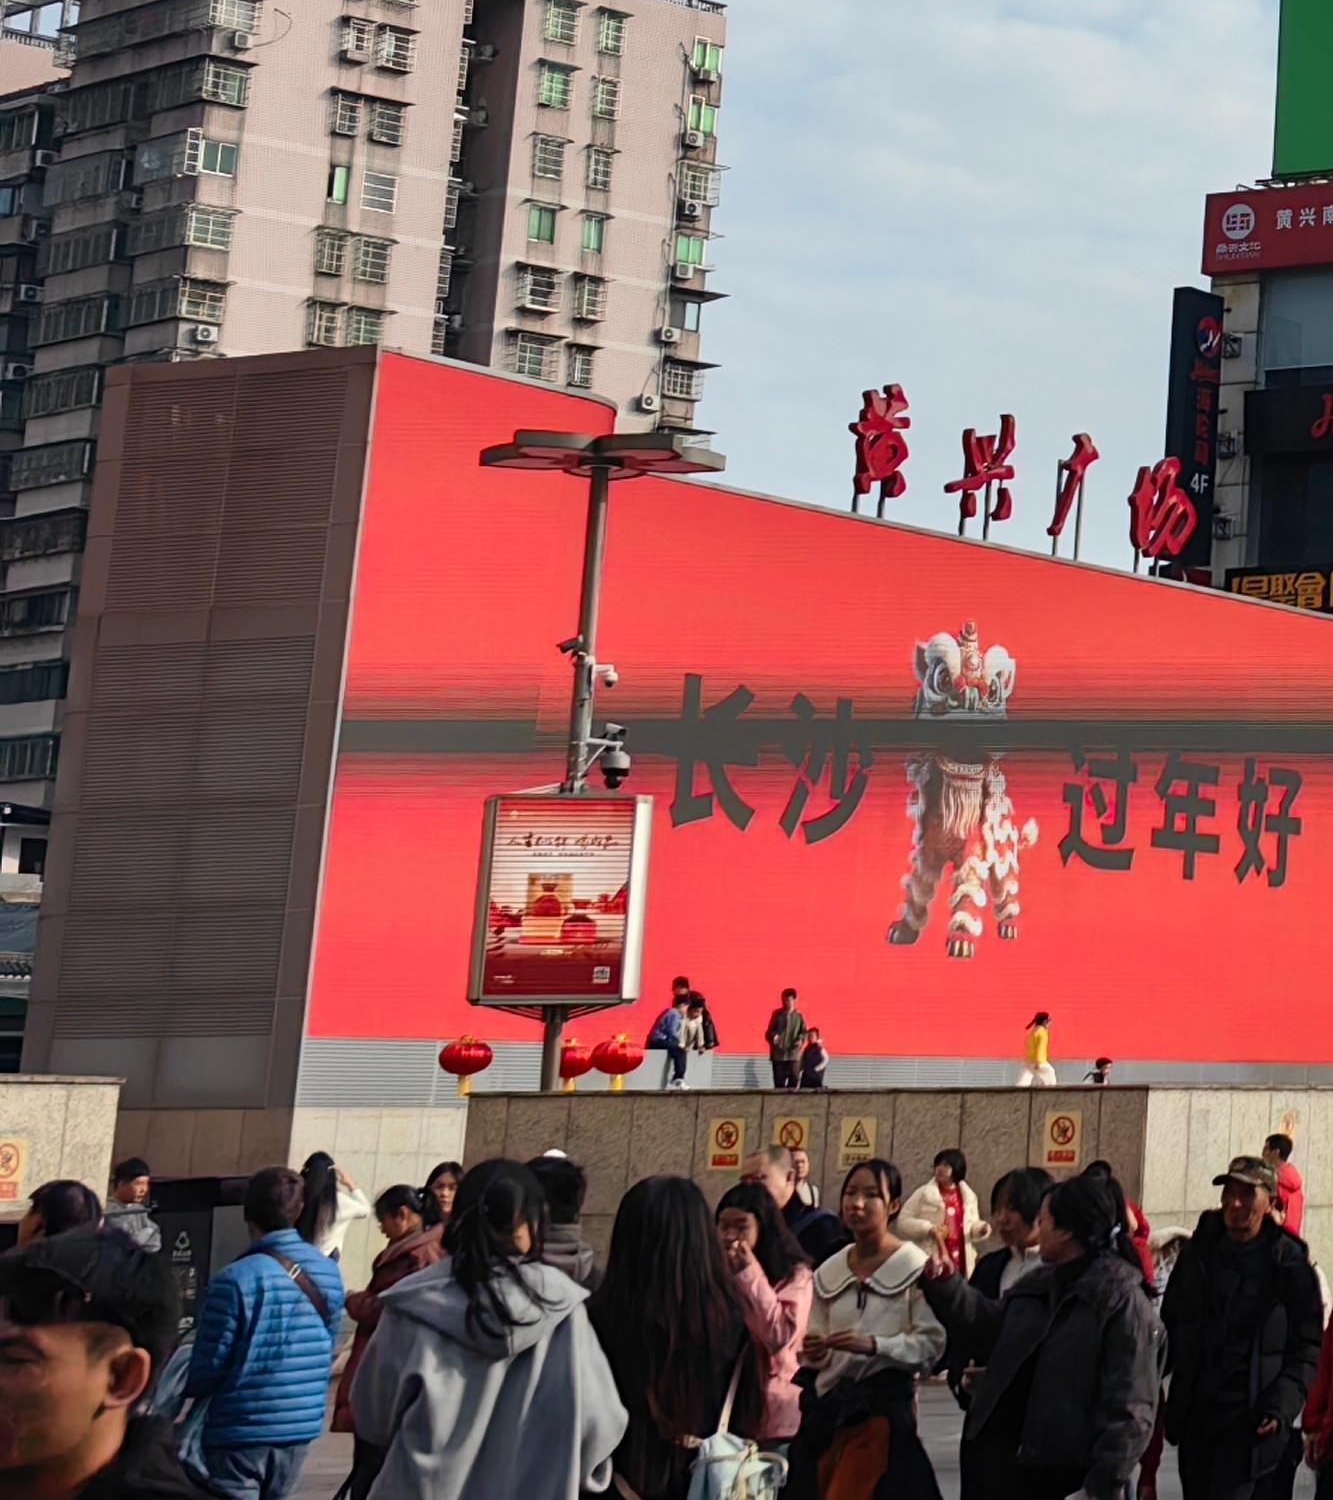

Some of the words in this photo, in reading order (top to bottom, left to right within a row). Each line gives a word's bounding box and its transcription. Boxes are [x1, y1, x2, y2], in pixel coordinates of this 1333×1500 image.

[1190, 473, 1209, 494] 4F
[669, 673, 874, 844] 长沙
[1057, 745, 1303, 887] 过年好
